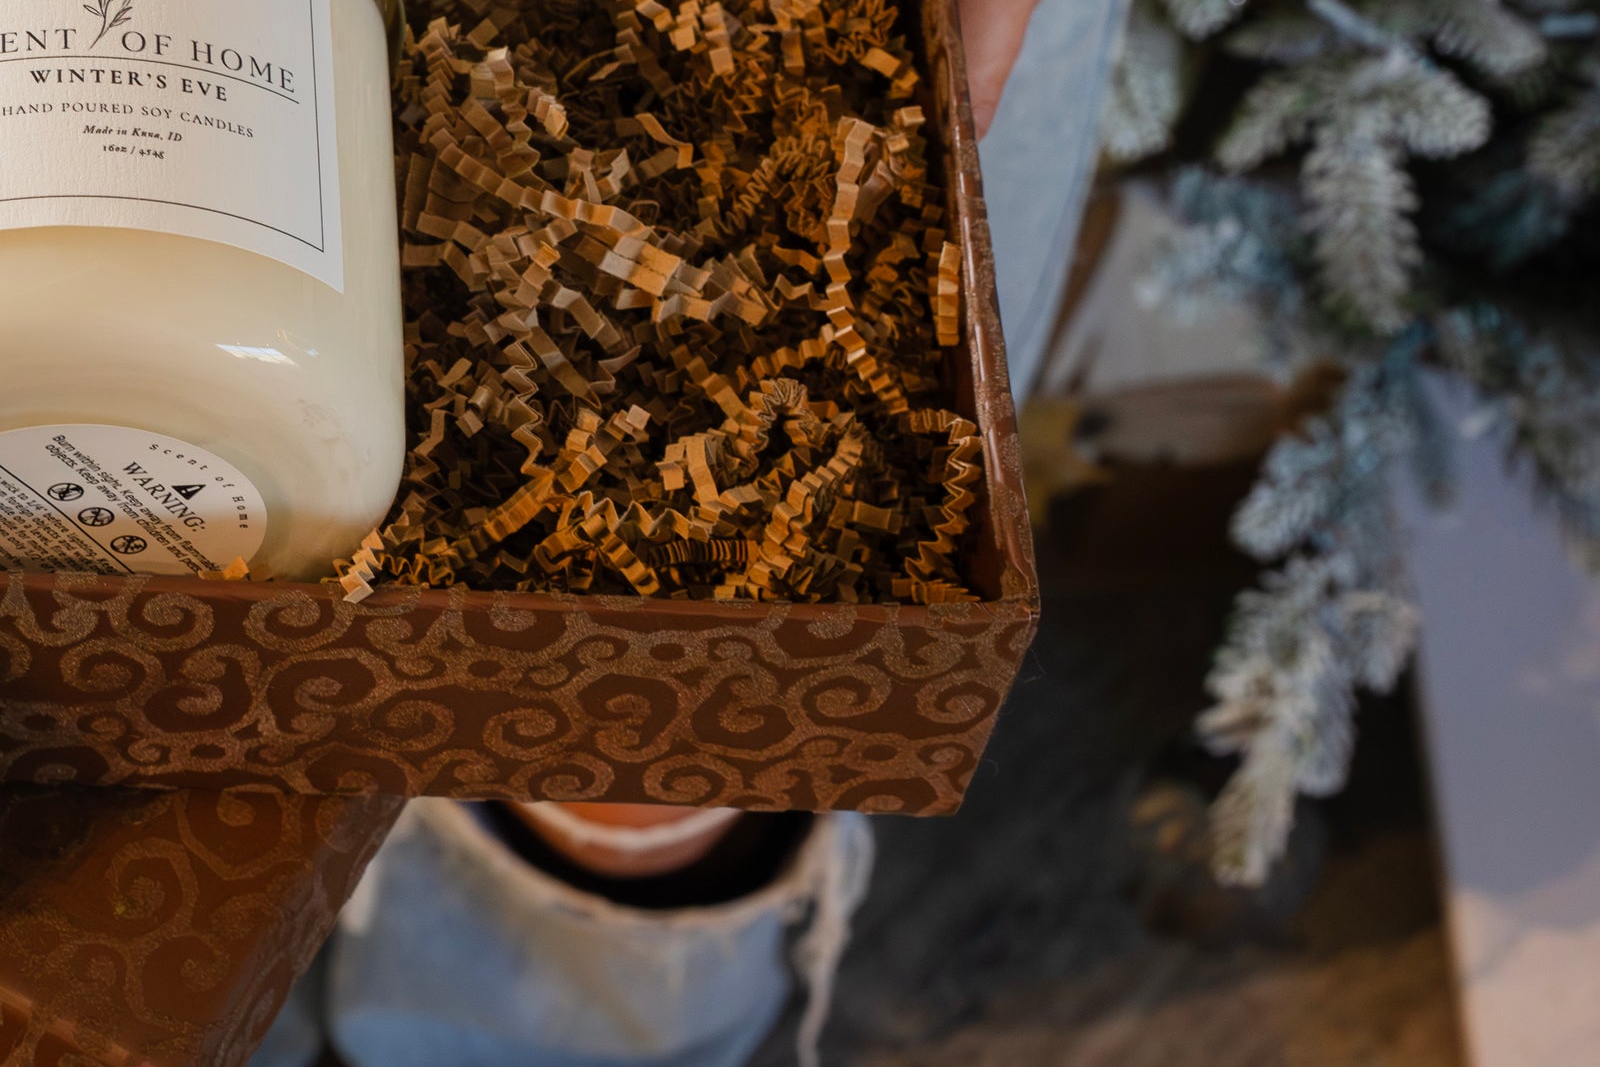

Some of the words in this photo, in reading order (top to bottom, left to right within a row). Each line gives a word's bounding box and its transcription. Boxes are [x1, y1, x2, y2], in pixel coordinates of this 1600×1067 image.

[122, 30, 173, 55] OF
[191, 40, 295, 93] HOME
[30, 69, 167, 88] WINTER'S
[181, 79, 228, 102] EVE
[2, 102, 53, 116] HAND
[62, 102, 134, 115] POURED
[142, 105, 174, 120] SOY
[180, 111, 254, 138] CANDLES
[83, 125, 113, 135] Made
[117, 127, 128, 136] in
[167, 132, 183, 142] ID
[0, 480, 20, 494] wick
[17, 492, 29, 501] to
[42, 512, 70, 533] before
[52, 434, 76, 452] Burn
[73, 451, 101, 472] within
[119, 489, 144, 508] Keep
[139, 507, 164, 525] away
[161, 524, 183, 542] from
[123, 461, 205, 532] WARNING:
[5, 496, 34, 518] foreign
[31, 517, 61, 540] objects
[57, 539, 77, 551] and
[12, 515, 26, 525] on
[75, 467, 104, 485] Keep
[96, 485, 121, 502] away
[117, 501, 140, 520] from
[135, 518, 171, 546] children
[166, 545, 188, 559] and
[7, 536, 26, 550] only
[15, 529, 31, 539] for
[27, 539, 49, 555] more
